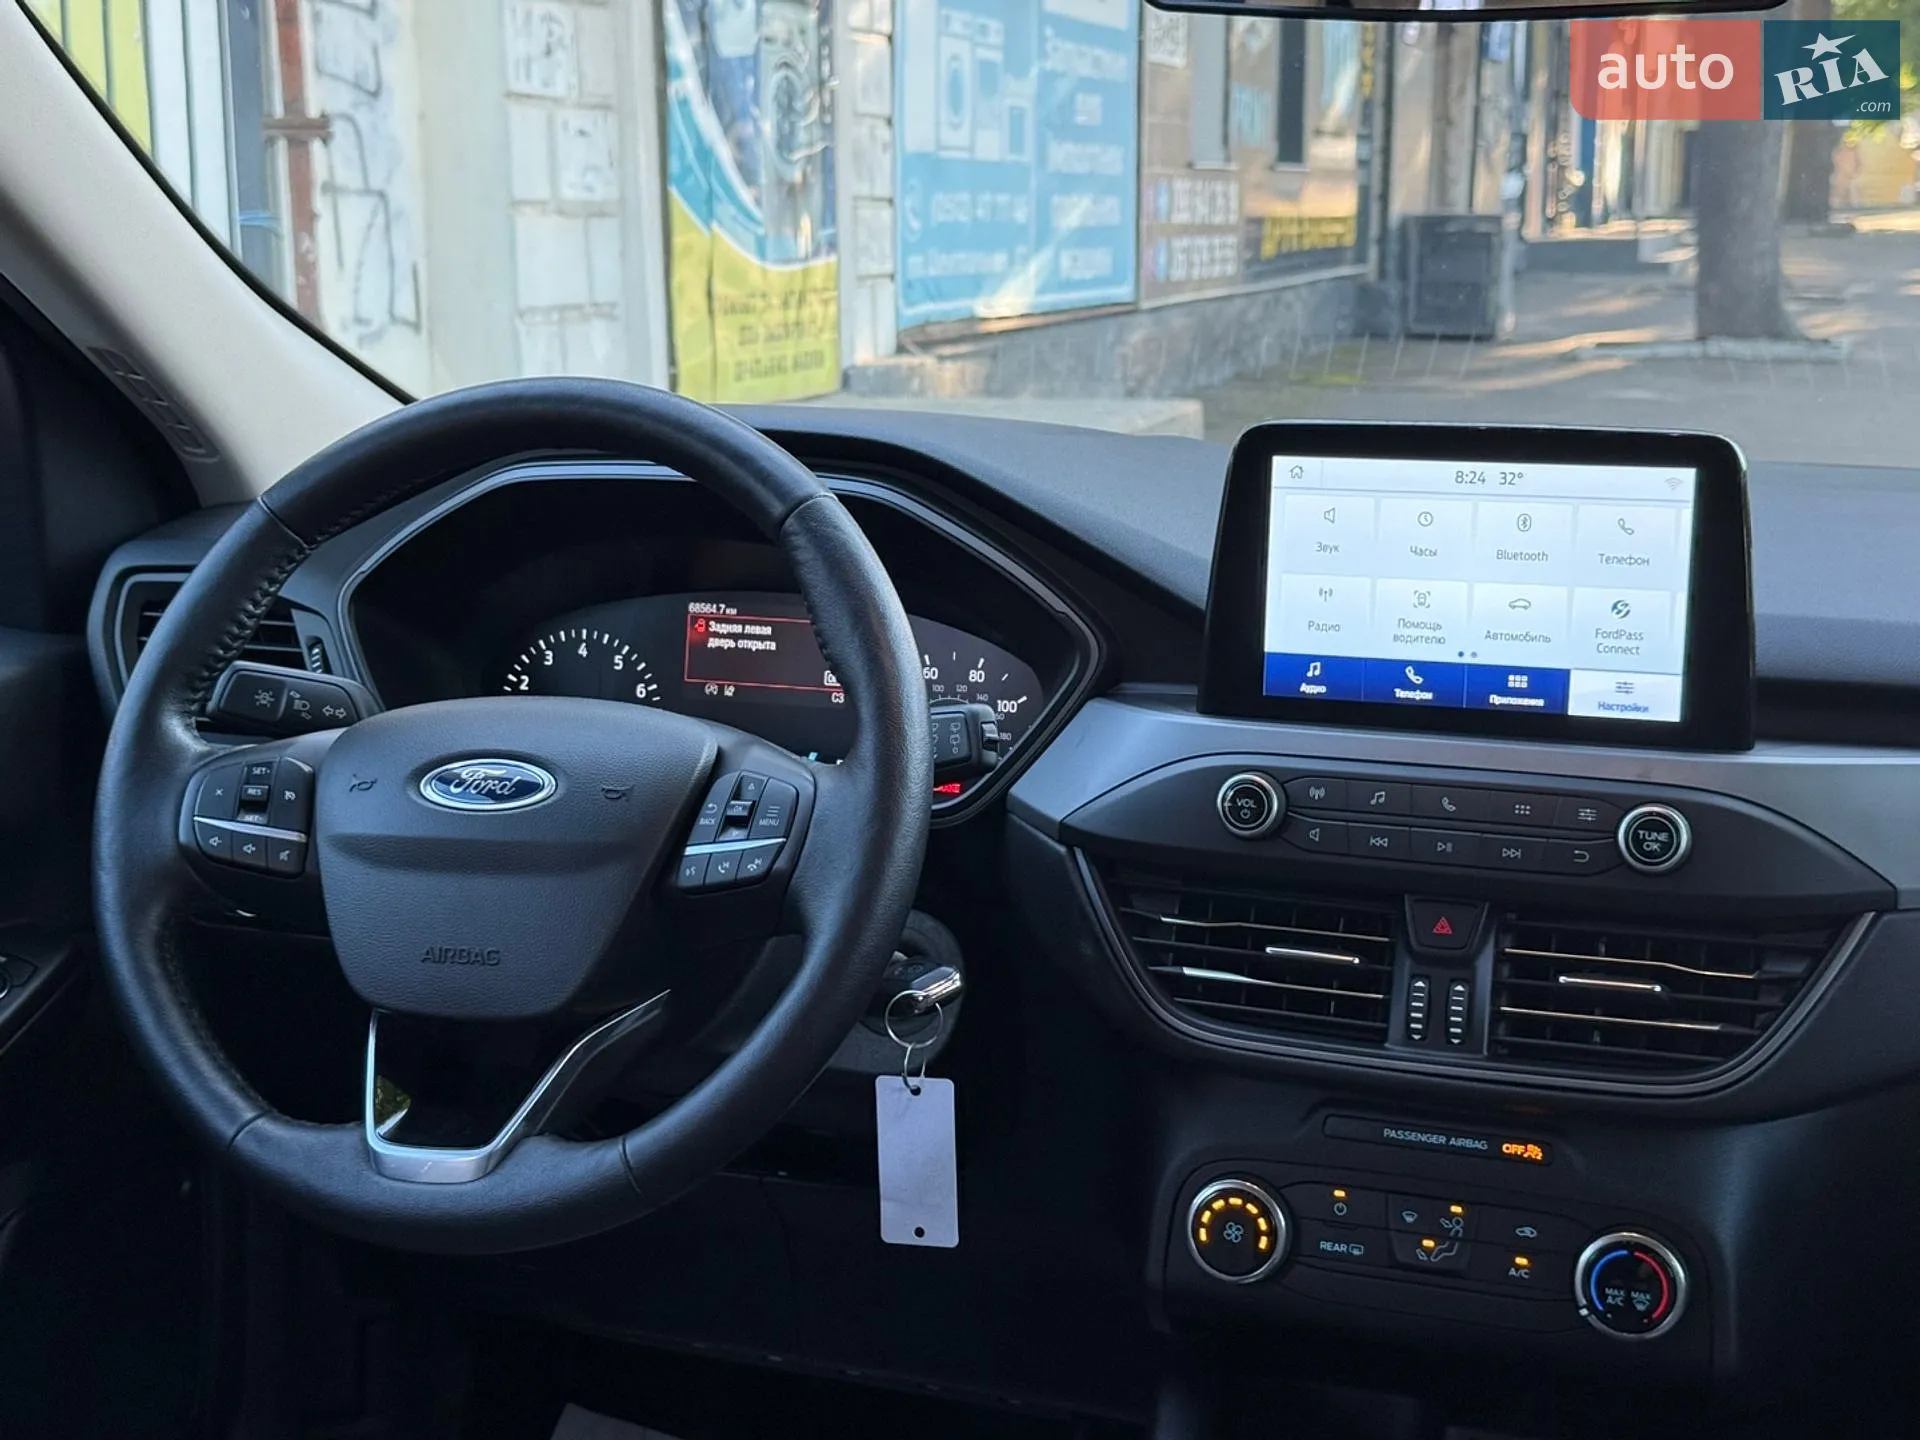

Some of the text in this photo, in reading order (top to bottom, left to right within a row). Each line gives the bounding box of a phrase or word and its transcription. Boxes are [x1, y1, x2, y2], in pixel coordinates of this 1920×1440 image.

[1454, 470, 1524, 486] 8:24 32°
[1315, 541, 1340, 555] Звук
[1410, 545, 1438, 557] Часы
[1496, 549, 1549, 562] Bluetooth
[1598, 553, 1650, 567] Телефон
[688, 602, 738, 616] 68564.7 км
[708, 621, 772, 636] Задняя левая
[1308, 620, 1341, 633] Радио
[1398, 618, 1443, 632] Помощь
[1393, 633, 1446, 646] водителю
[1484, 629, 1552, 644] Автомобиль
[1595, 628, 1644, 641] FordPass
[577, 642, 588, 657] 4
[707, 637, 777, 651] дверь открыта
[1596, 643, 1640, 656] Connect
[543, 651, 554, 666] 3
[613, 655, 624, 670] 5
[922, 667, 938, 680] 60
[968, 670, 985, 683] 80
[518, 675, 529, 690] 2
[932, 684, 945, 692] 100
[956, 684, 968, 692] 120
[1300, 683, 1327, 695] Аудио
[635, 683, 646, 699] 6
[1394, 688, 1433, 701] Телефон
[997, 700, 1018, 713] 100
[1489, 695, 1545, 708] Приложения
[1597, 701, 1649, 714] Настройки
[449, 767, 522, 797] Ford
[1236, 797, 1257, 808] VOL
[759, 818, 780, 826] MENU
[1637, 829, 1669, 842] TUNE
[1642, 841, 1661, 852] OK
[420, 946, 500, 967] AIRBAG
[1383, 1128, 1489, 1150] PASSENGER AIRBAG
[1501, 1142, 1525, 1155] OFF
[1320, 1240, 1348, 1254] REAR
[1508, 1267, 1531, 1279] A/C
[1605, 1287, 1625, 1297] MAX
[1631, 1291, 1651, 1300] MAX
[1606, 1295, 1624, 1306] A/C
